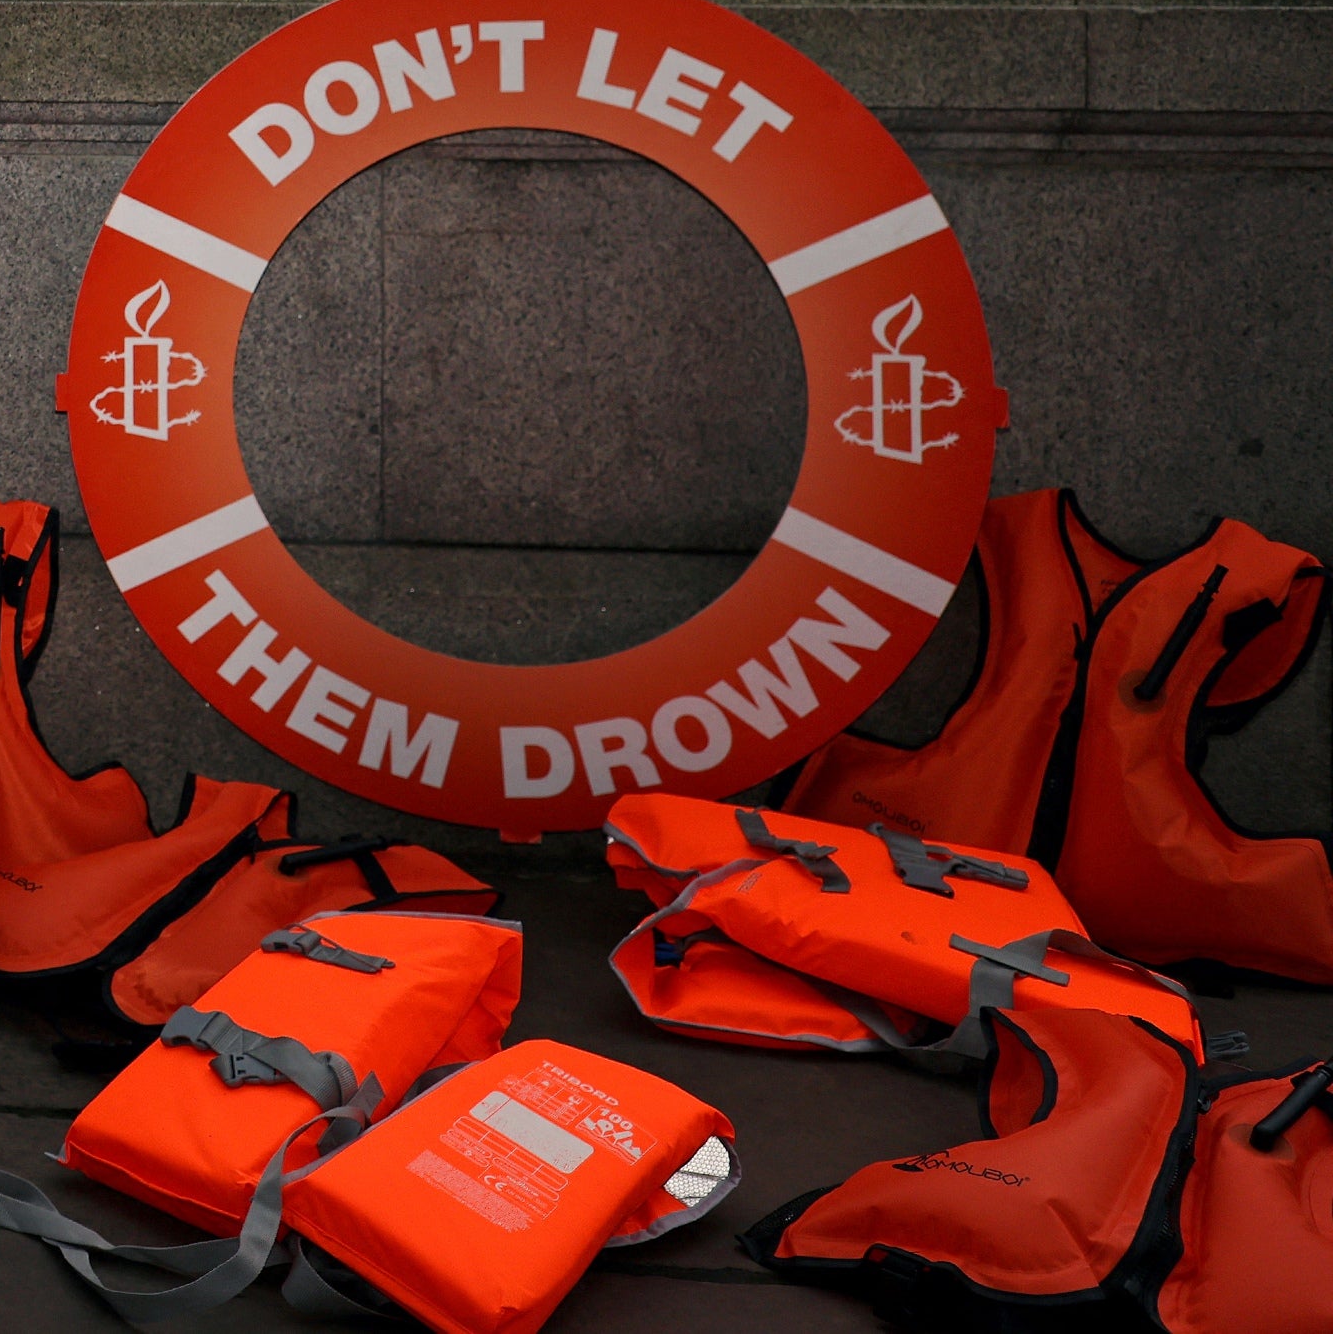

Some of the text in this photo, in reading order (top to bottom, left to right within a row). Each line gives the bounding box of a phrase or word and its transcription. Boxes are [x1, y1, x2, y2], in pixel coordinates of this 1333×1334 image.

[229, 21, 793, 186] DON'T LET
[178, 570, 889, 796] THEM DROWN
[541, 1060, 619, 1106] TRIBORD
[600, 1107, 633, 1131] 100
